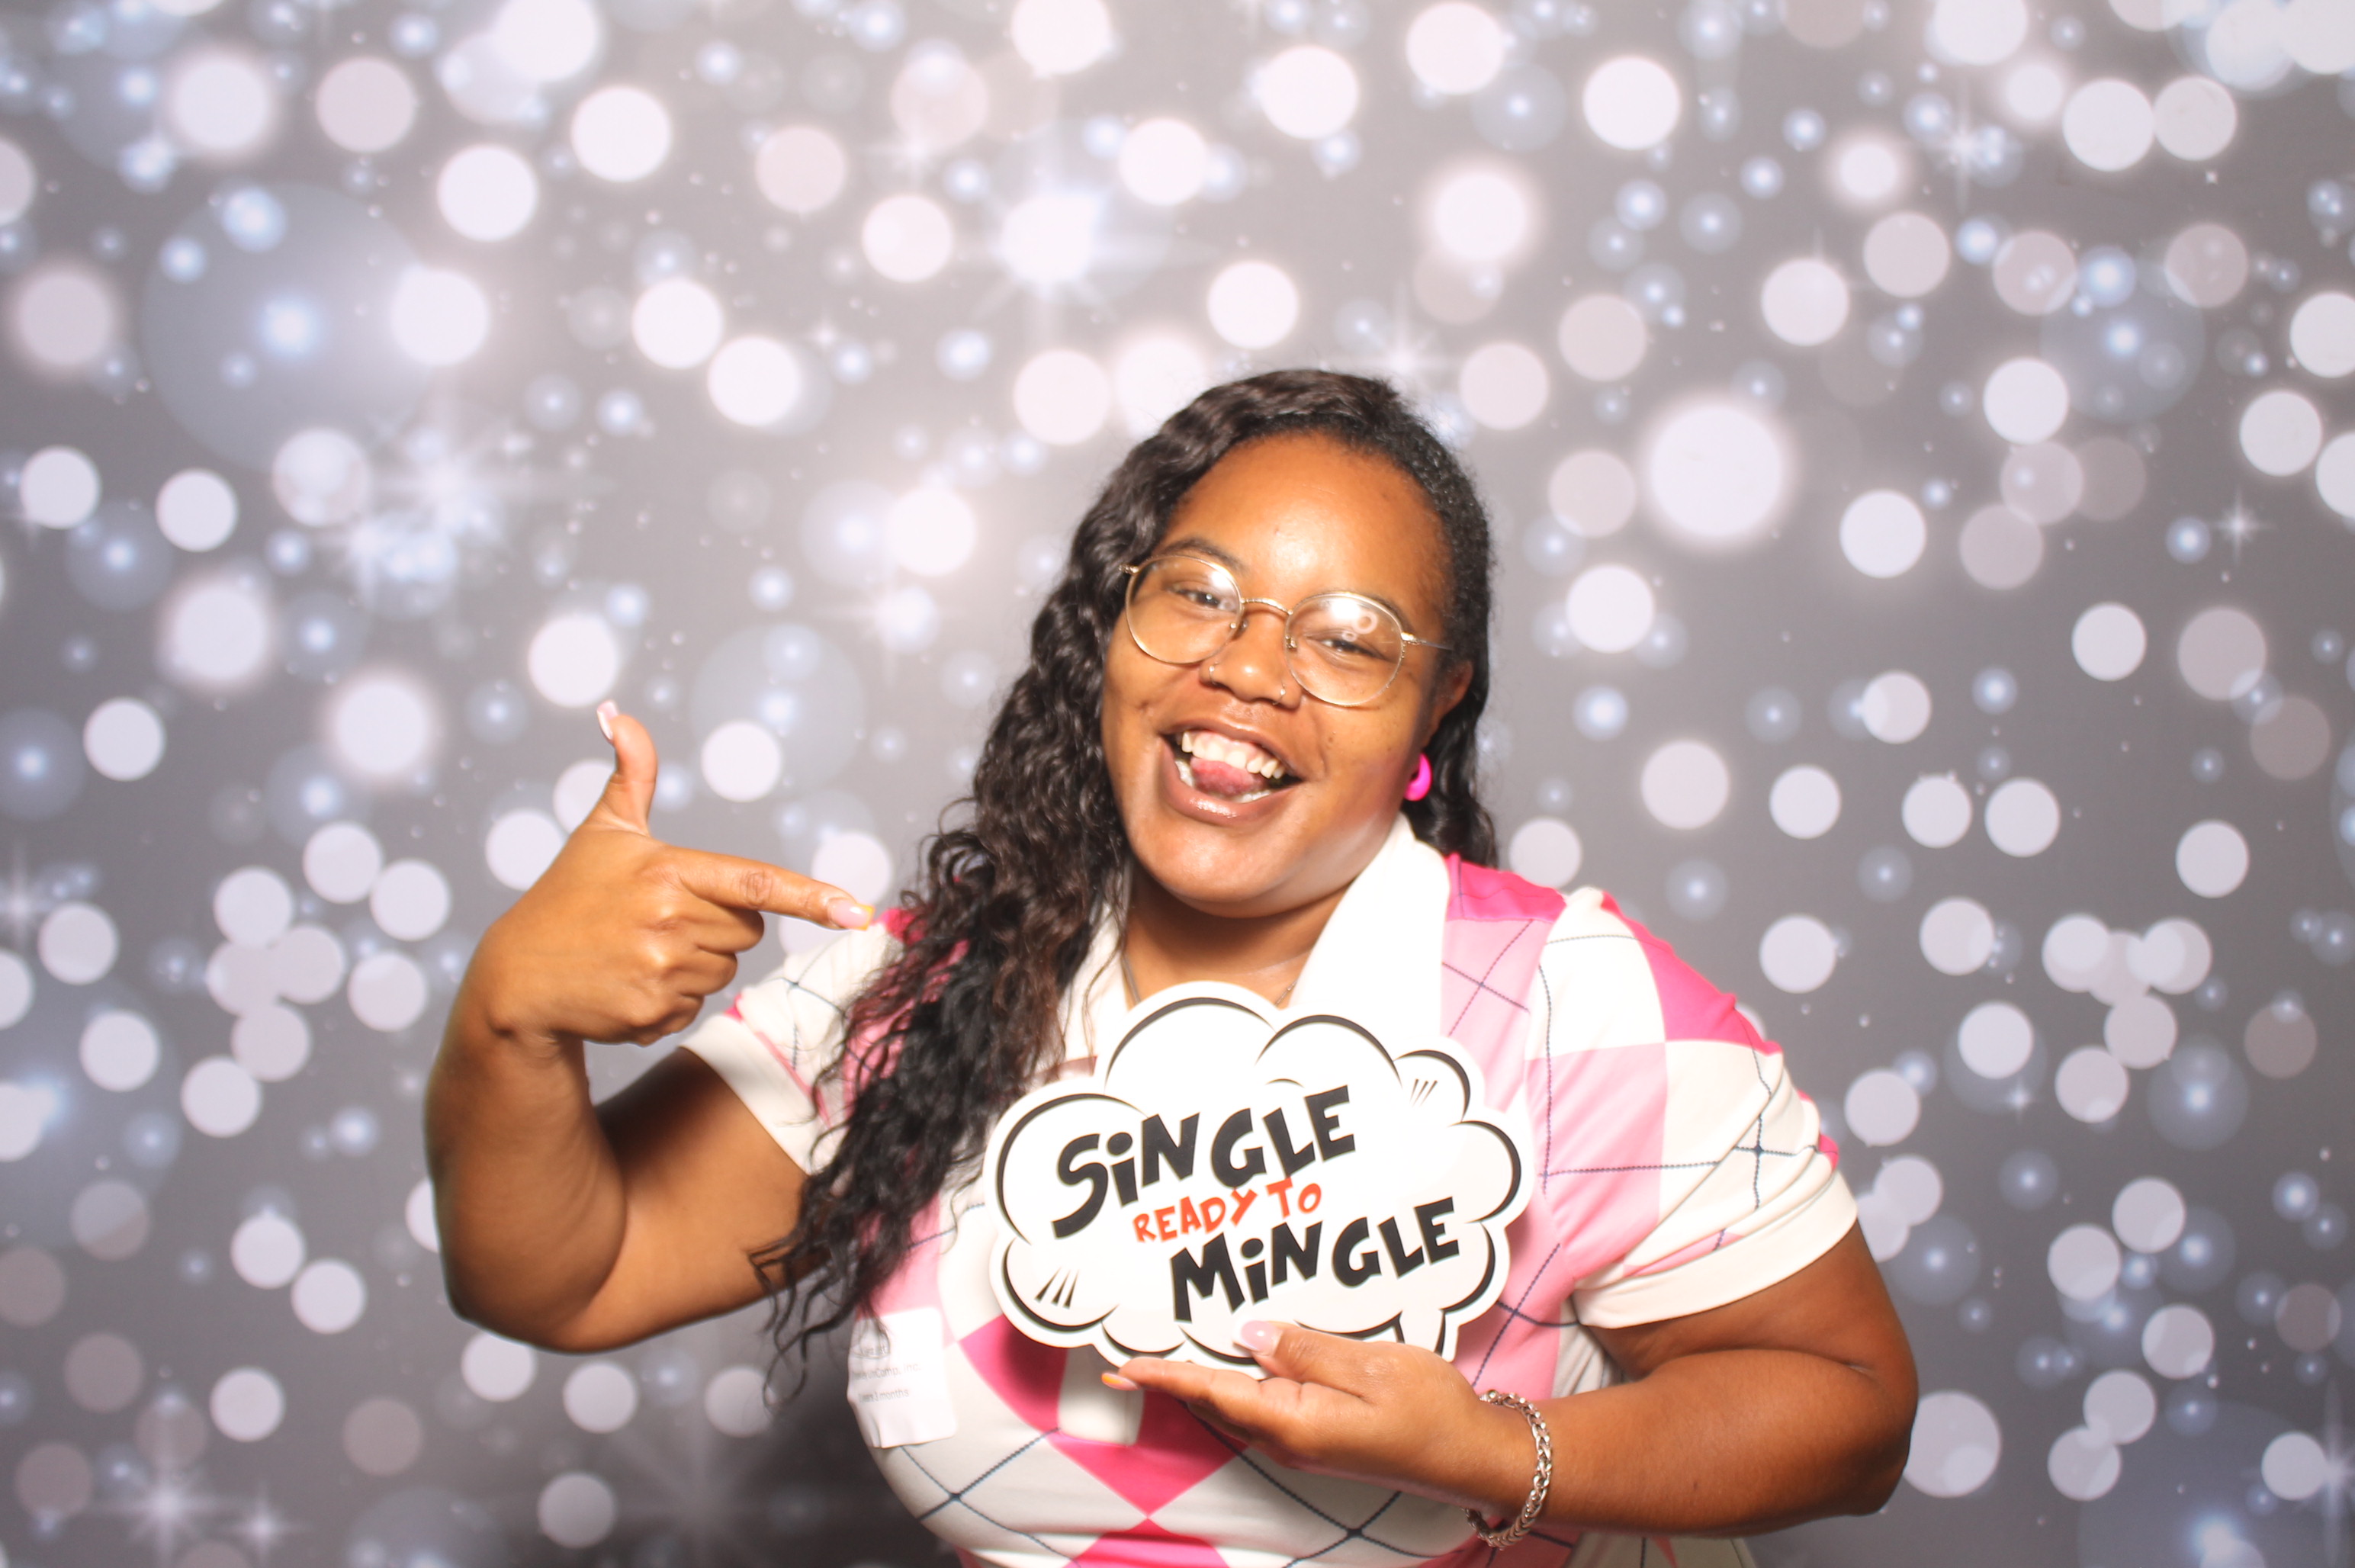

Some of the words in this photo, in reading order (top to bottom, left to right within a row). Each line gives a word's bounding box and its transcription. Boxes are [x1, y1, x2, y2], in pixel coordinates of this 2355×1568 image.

[1133, 1187, 1259, 1243] READY
[1265, 1176, 1323, 1219] TO
[879, 1387, 910, 1401] months
